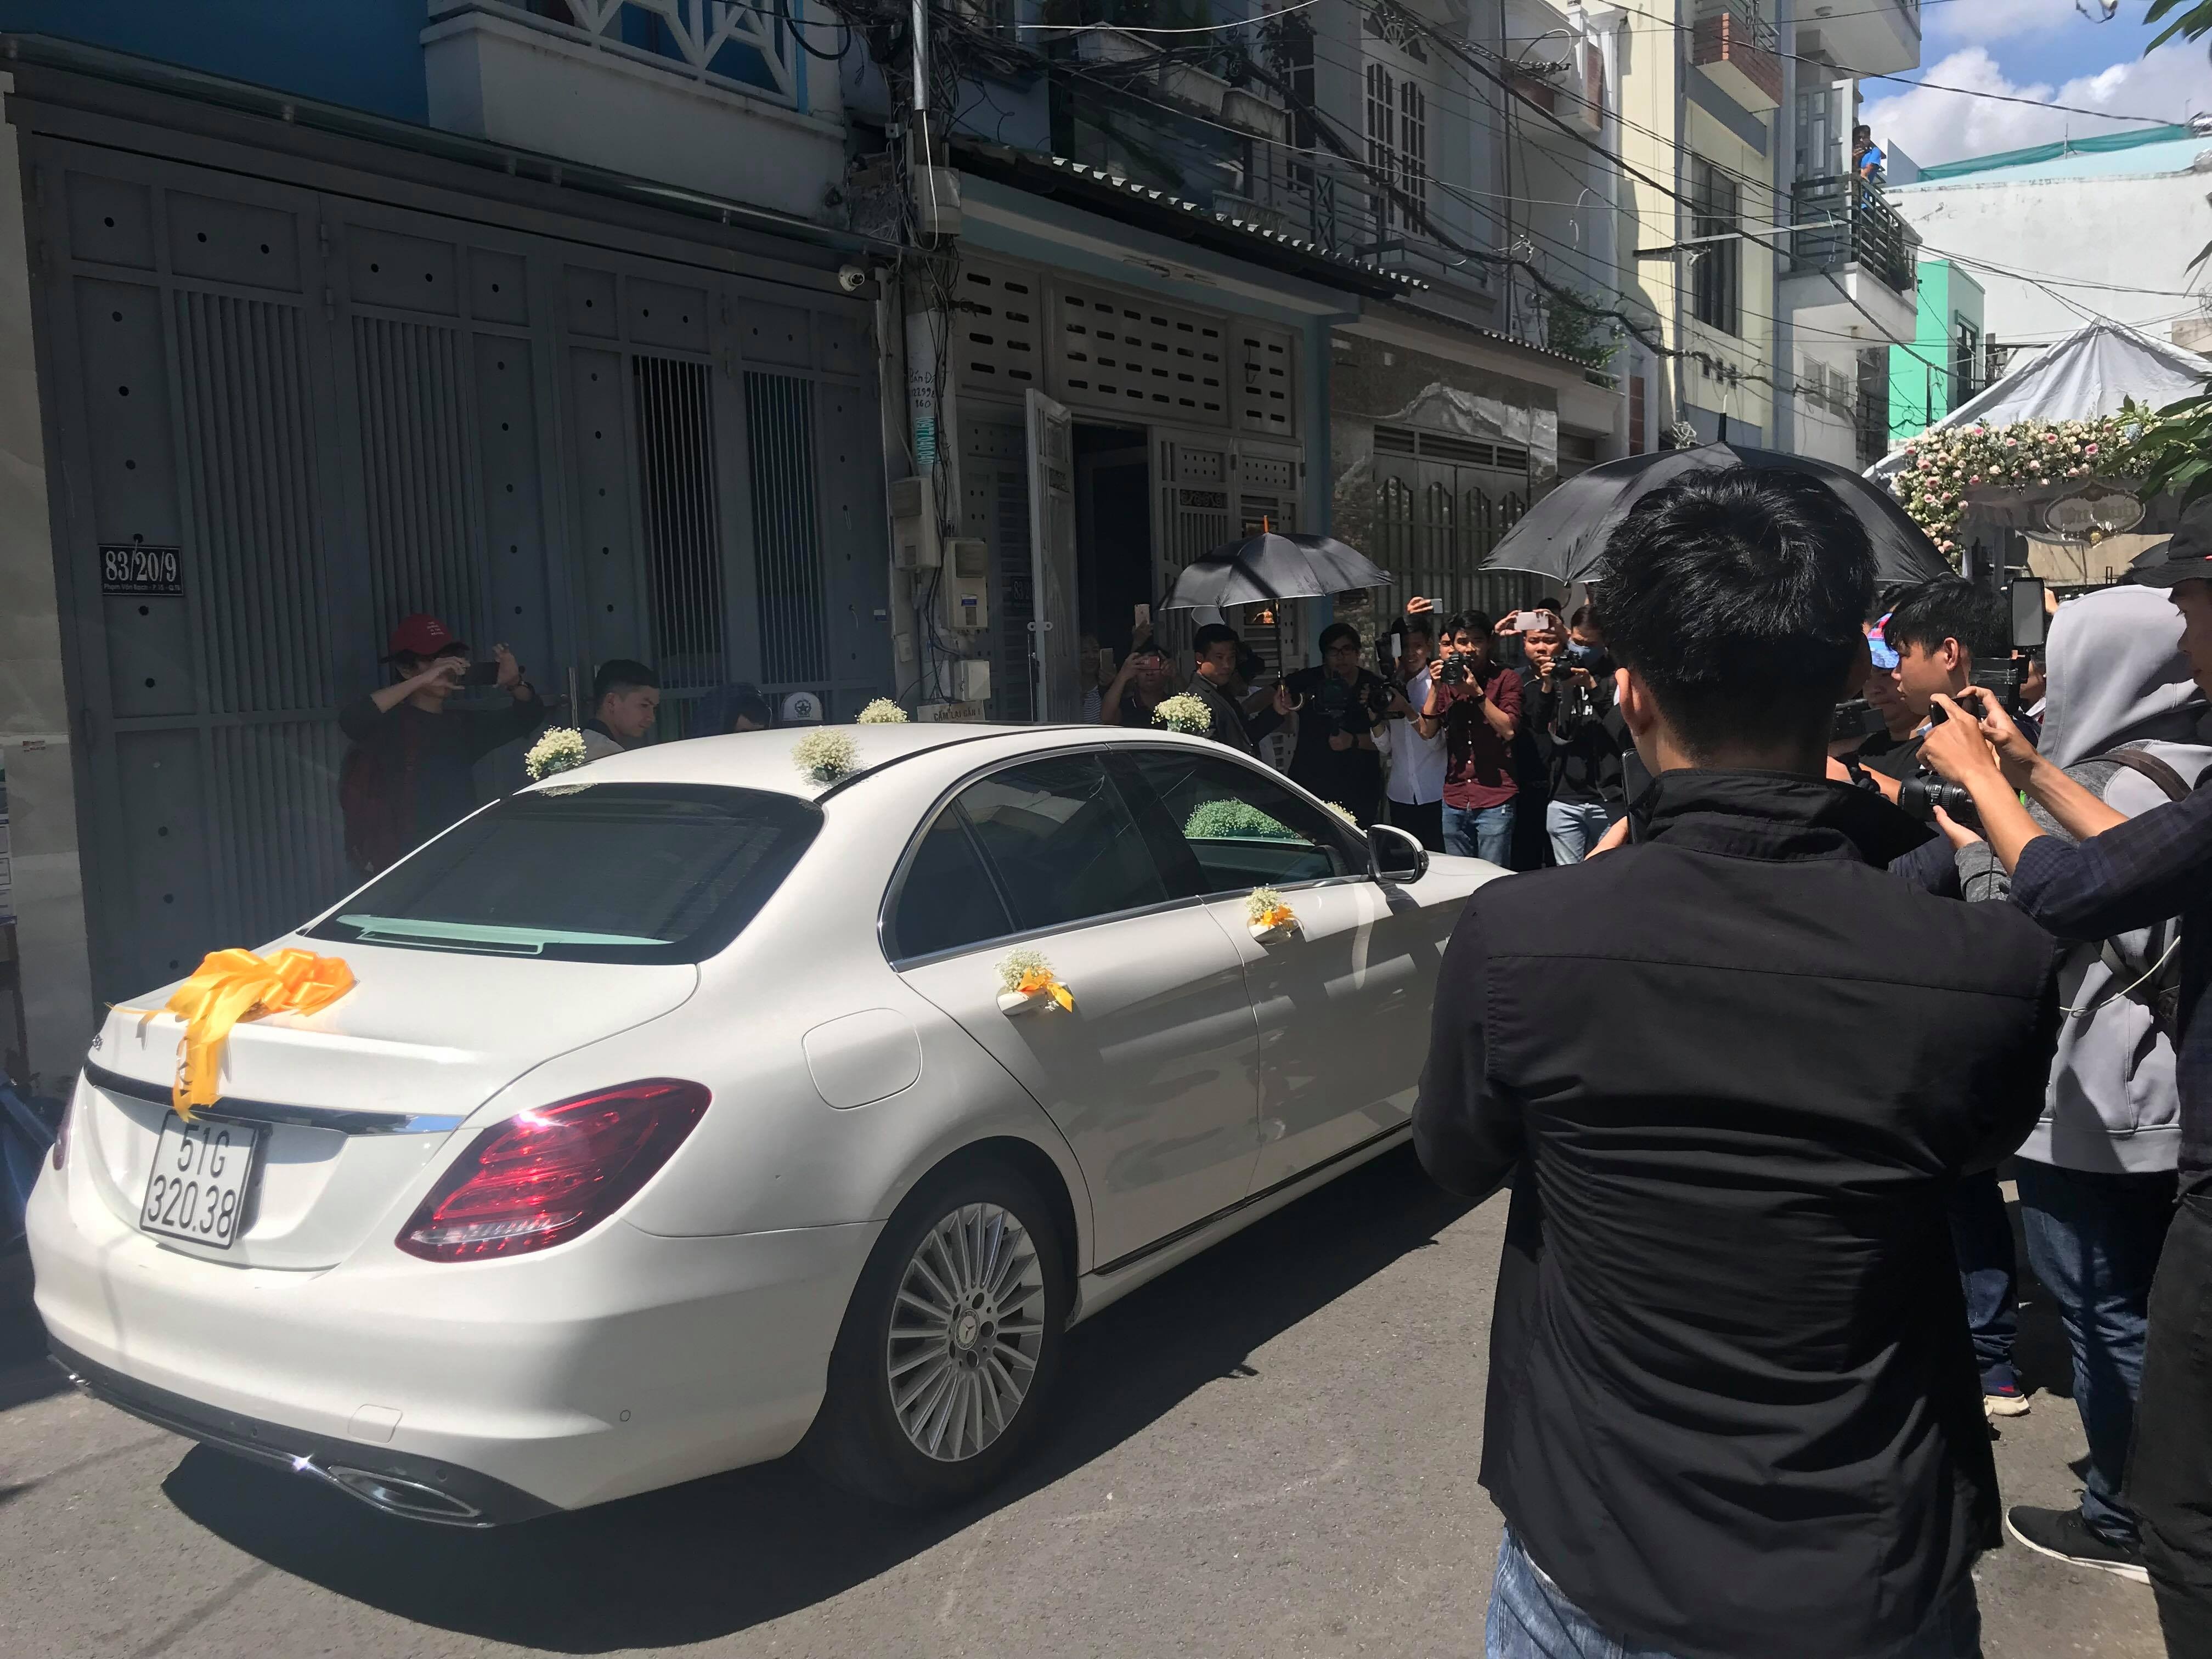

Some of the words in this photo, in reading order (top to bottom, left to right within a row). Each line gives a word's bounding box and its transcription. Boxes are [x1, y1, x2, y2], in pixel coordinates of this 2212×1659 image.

[105, 550, 177, 582] 83/20/9
[177, 1124, 230, 1178] 51G
[148, 1174, 236, 1239] 320.38
